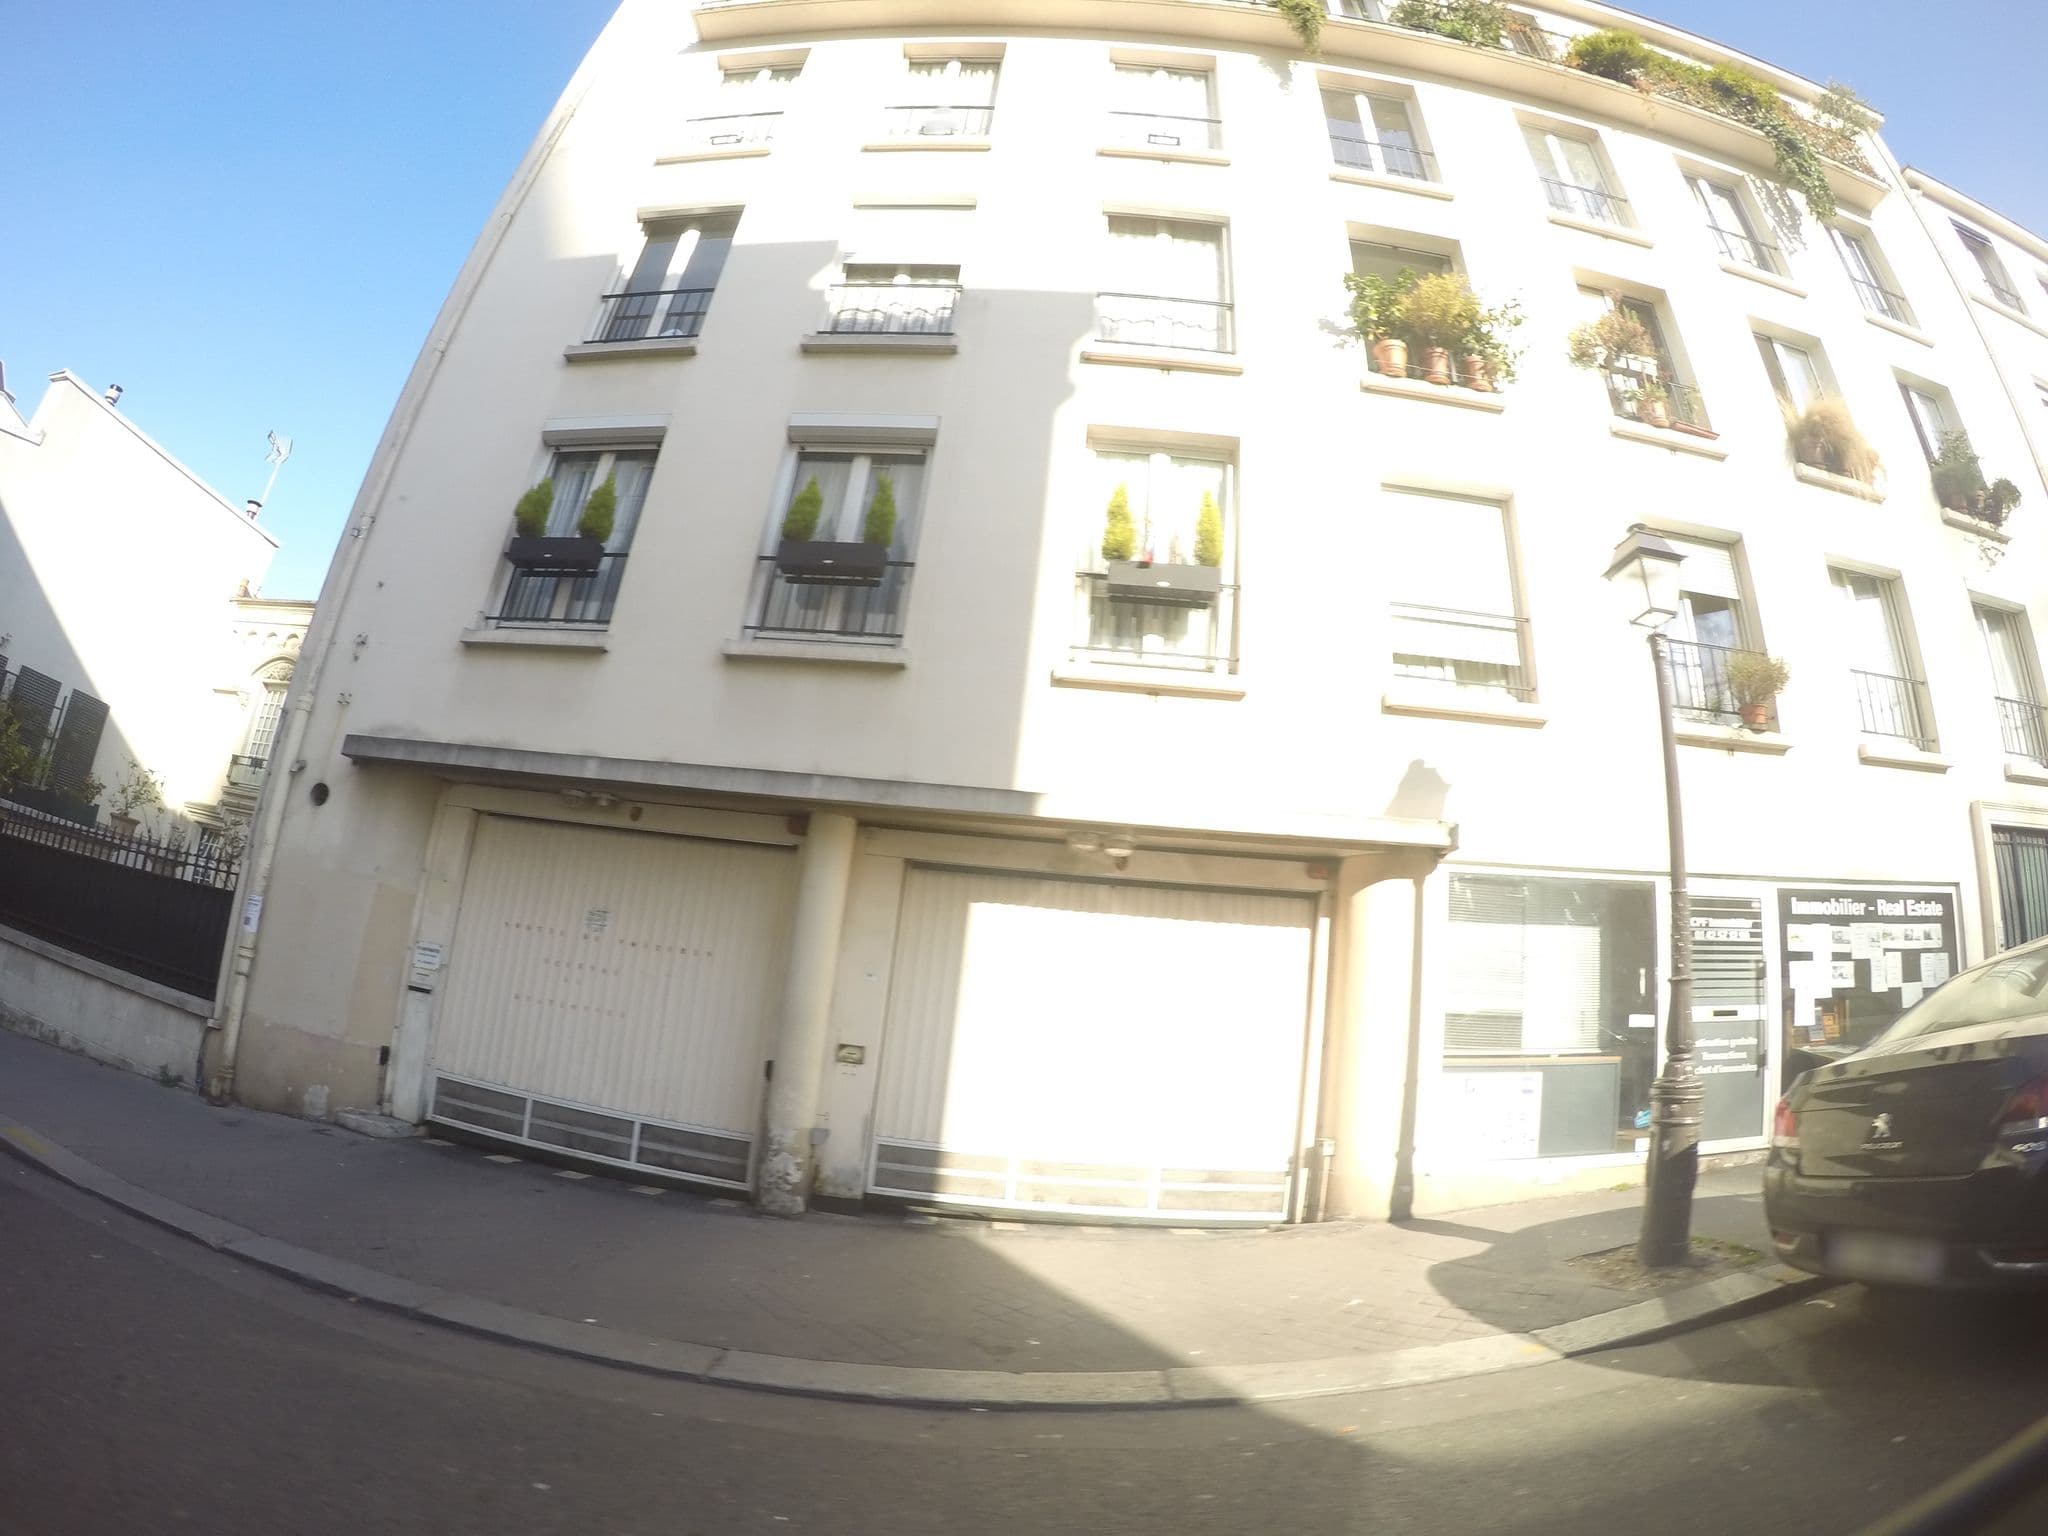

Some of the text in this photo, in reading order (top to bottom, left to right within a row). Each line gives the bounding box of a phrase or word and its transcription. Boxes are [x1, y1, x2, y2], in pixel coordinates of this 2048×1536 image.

[1790, 897, 1866, 915] Immobilier
[1877, 898, 1905, 916] Real
[1906, 899, 1943, 916] Estate
